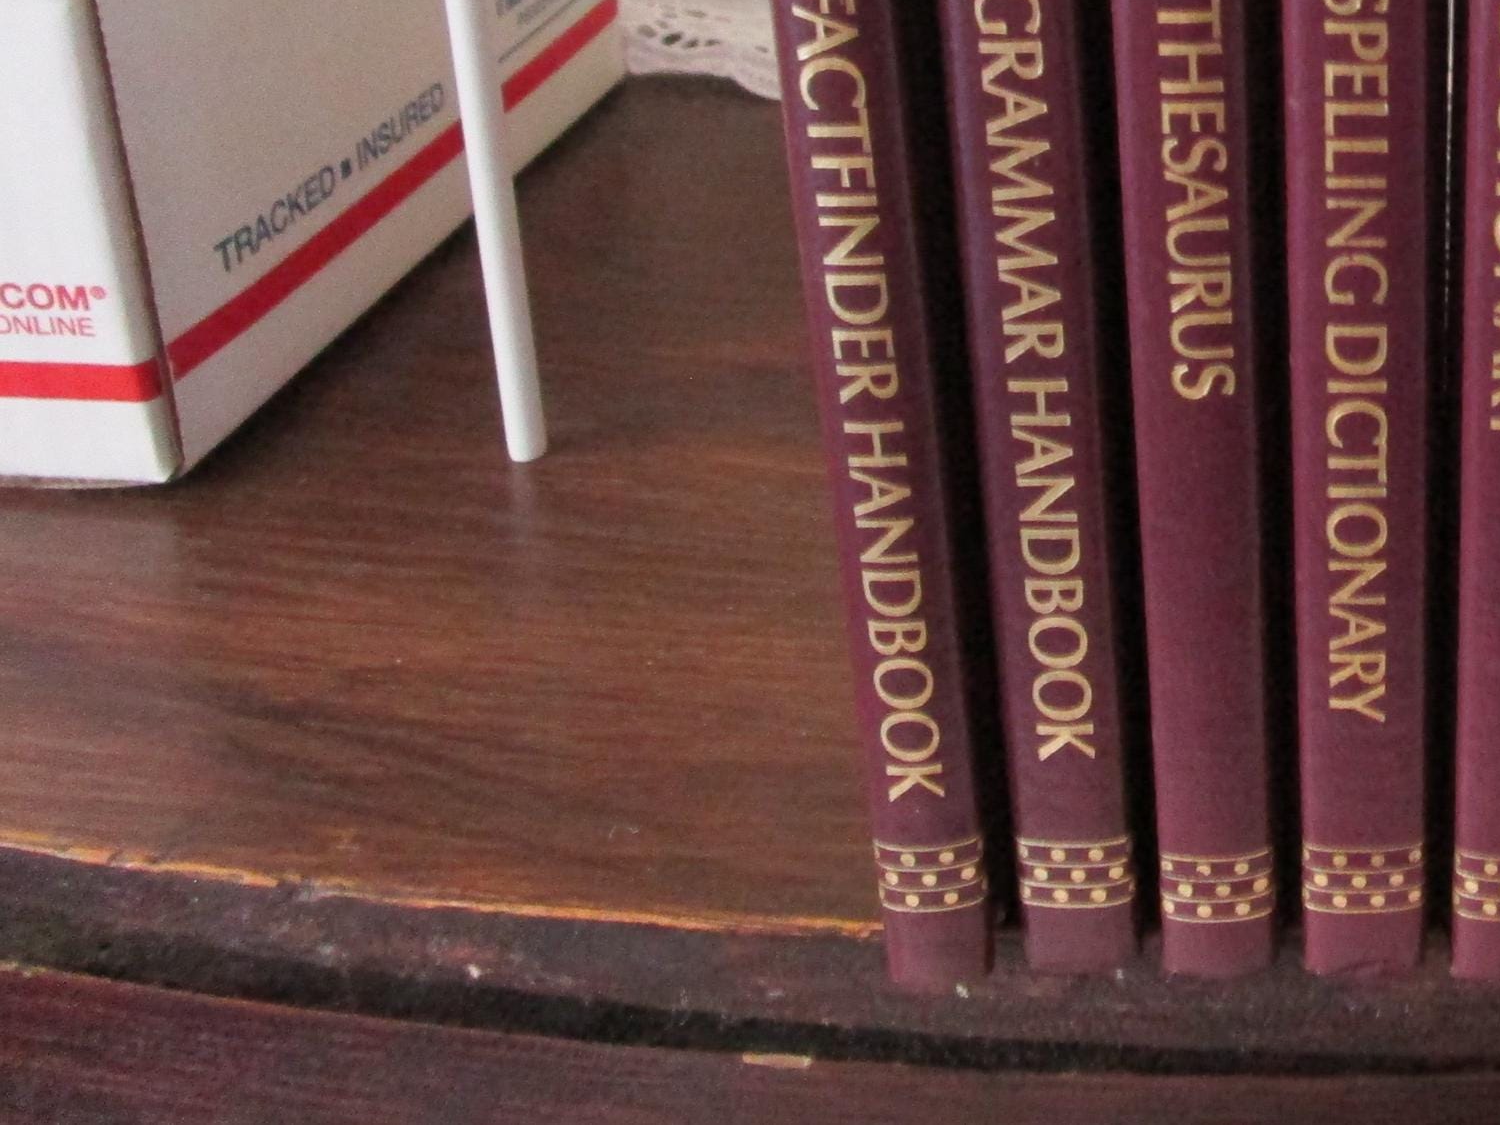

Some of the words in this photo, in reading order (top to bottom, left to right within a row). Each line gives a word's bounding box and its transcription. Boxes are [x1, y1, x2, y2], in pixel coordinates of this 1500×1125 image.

[213, 164, 336, 273] TRACKED
[355, 82, 445, 171] INSURED
[843, 420, 945, 803] HANDBOOK
[1008, 378, 1096, 762] HANDBOOK
[1325, 324, 1389, 724] DICTIONARY
